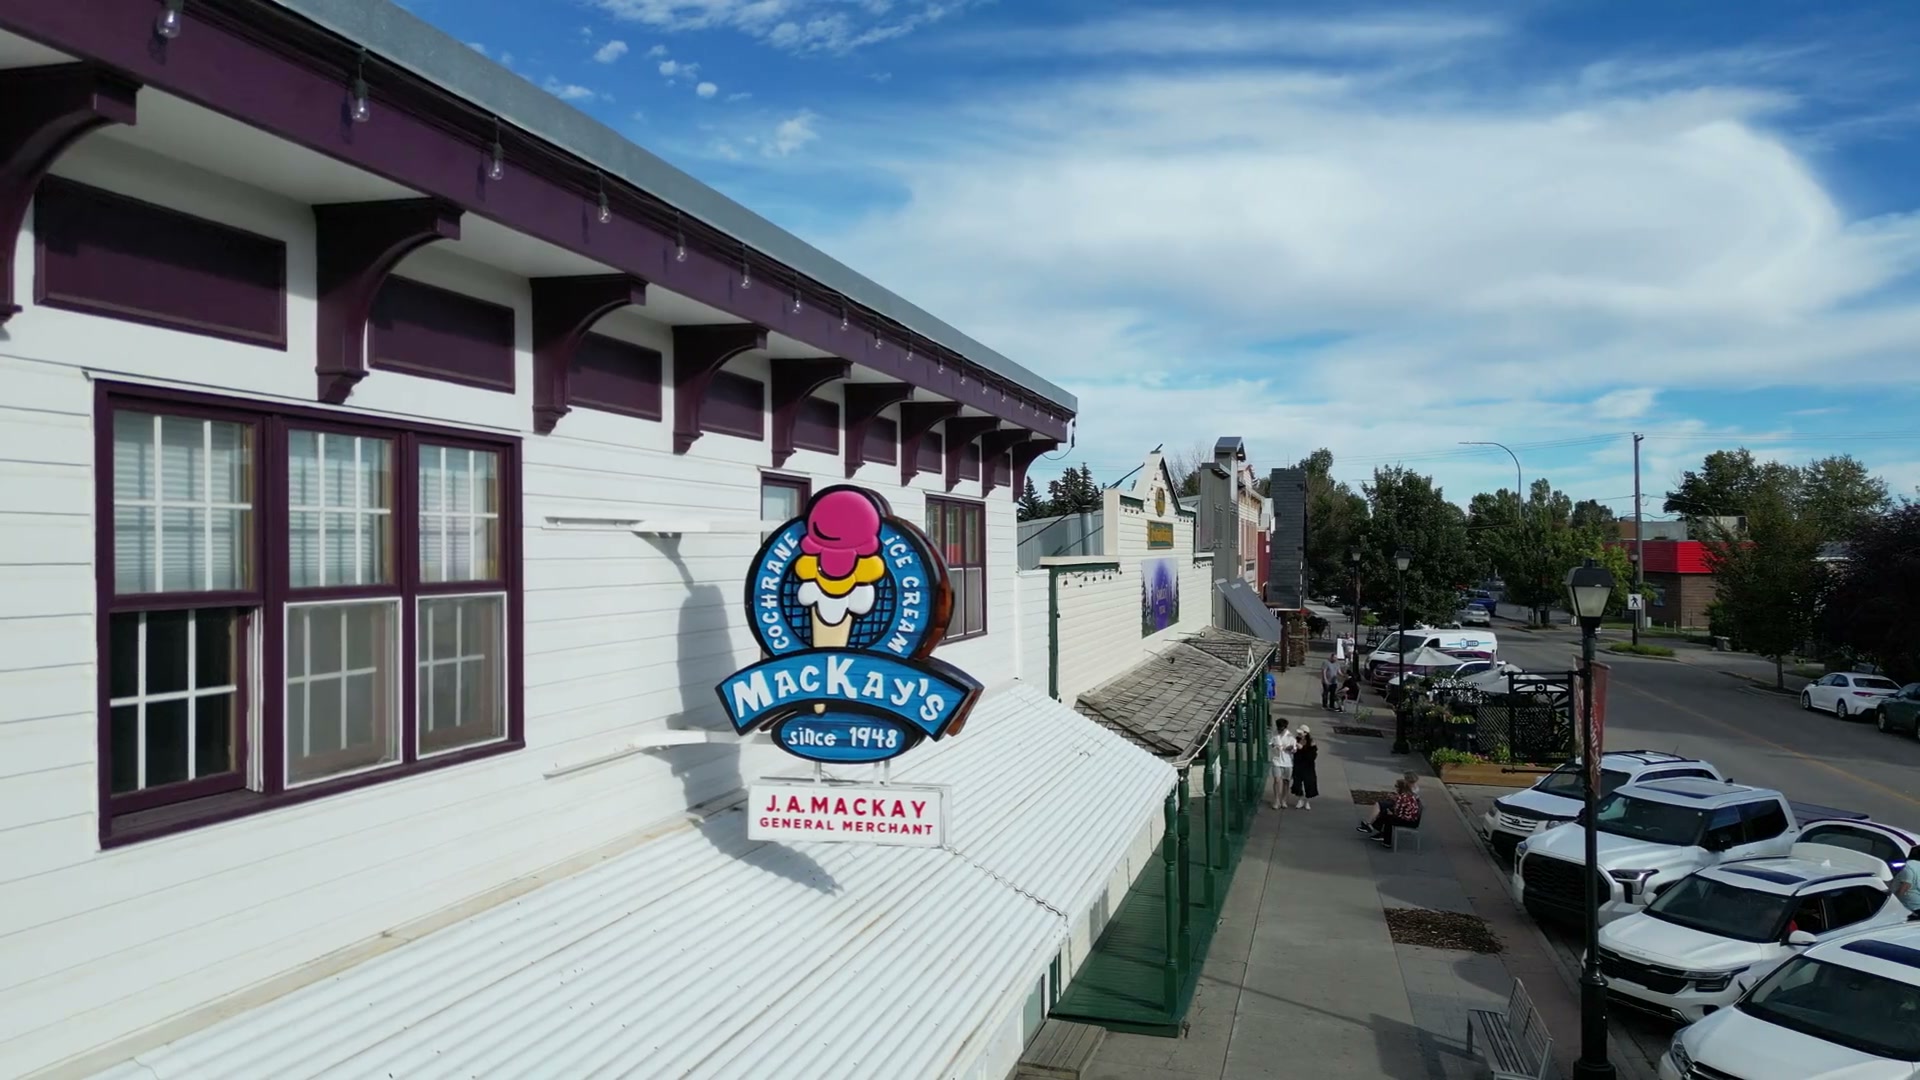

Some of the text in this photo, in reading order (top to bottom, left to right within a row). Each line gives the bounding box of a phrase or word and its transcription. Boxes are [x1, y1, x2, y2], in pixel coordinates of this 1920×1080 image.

[761, 532, 799, 649] COCHRANE
[887, 576, 920, 653] CREAM
[787, 726, 898, 748] since 1948
[759, 817, 933, 835] GENERAL MERCHANT
